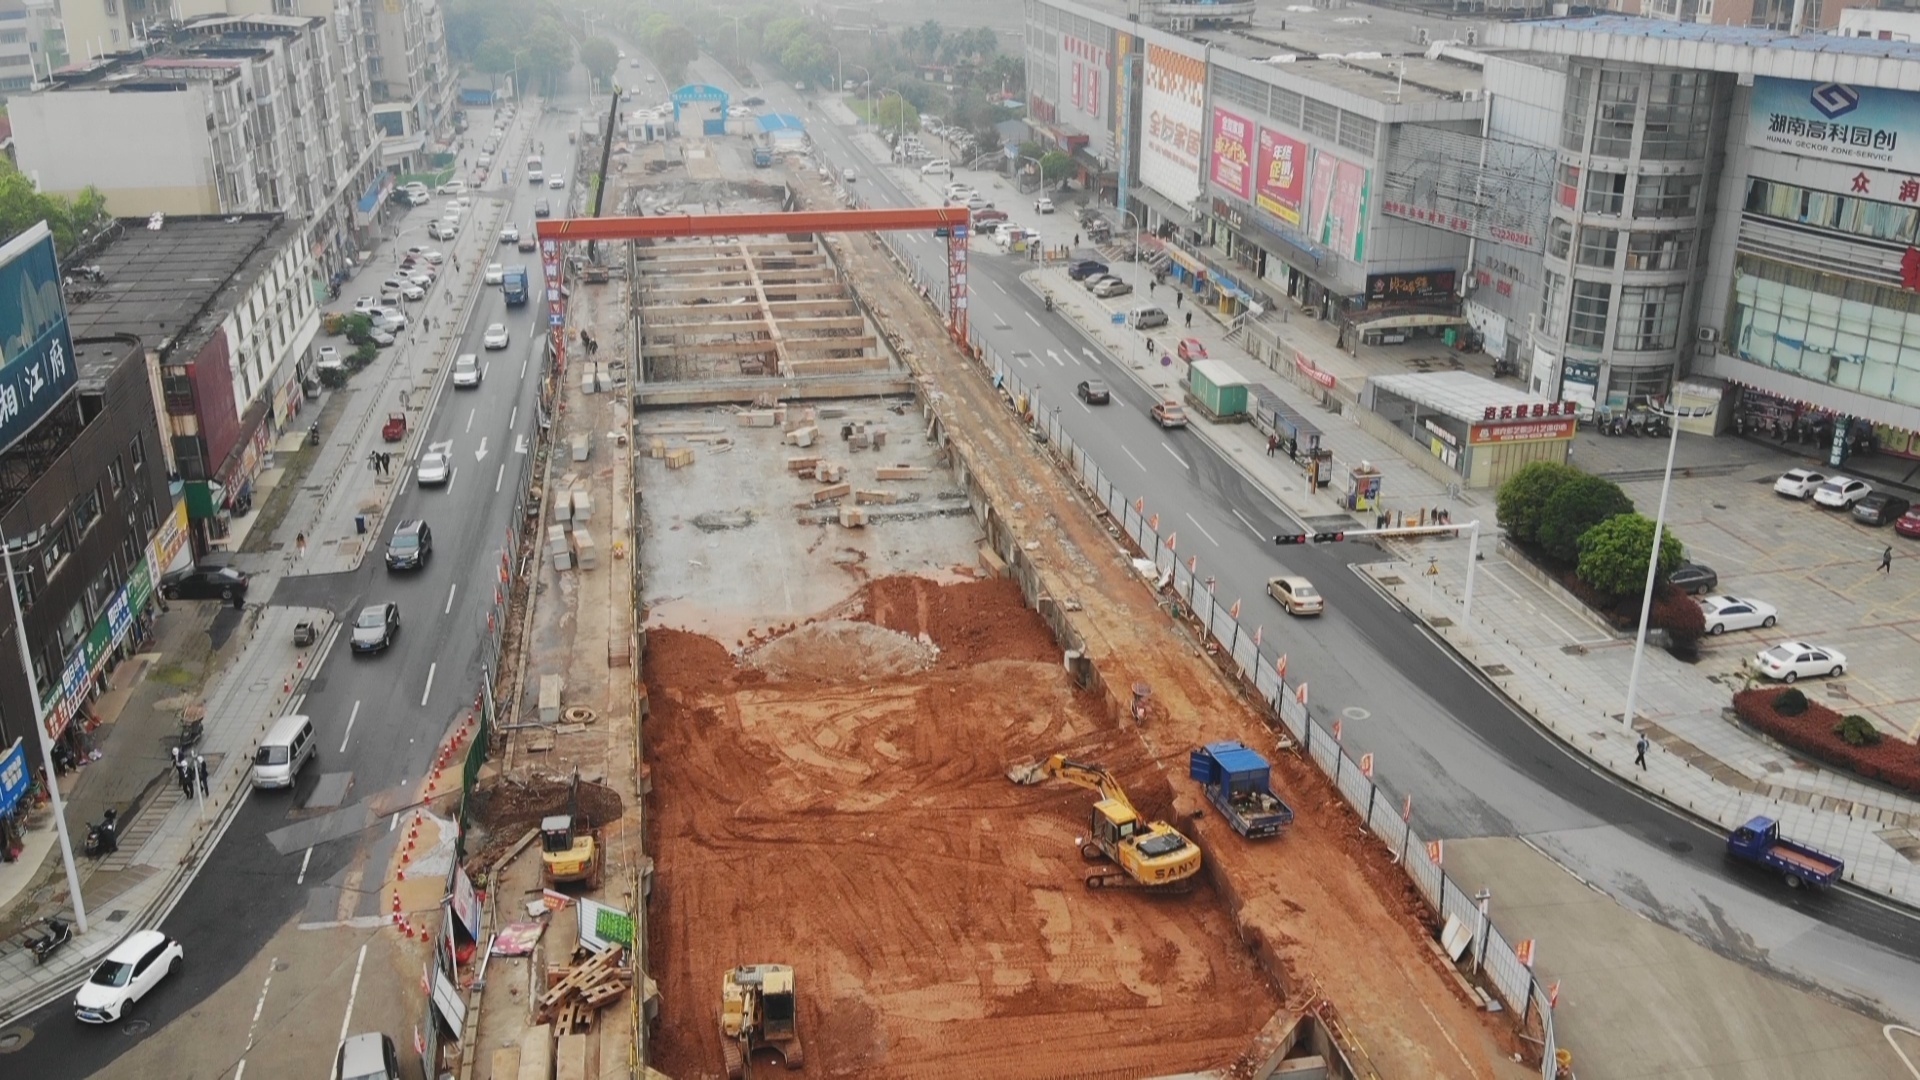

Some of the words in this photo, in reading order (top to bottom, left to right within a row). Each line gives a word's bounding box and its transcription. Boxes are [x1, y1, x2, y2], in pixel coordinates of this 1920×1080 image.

[1768, 112, 1898, 151] 湖南高科园创
[1766, 135, 1792, 146] HUNAN
[1796, 140, 1829, 152] GECKOR
[1831, 147, 1894, 162] ZONE-SERVICE
[1154, 858, 1197, 880] SANY
